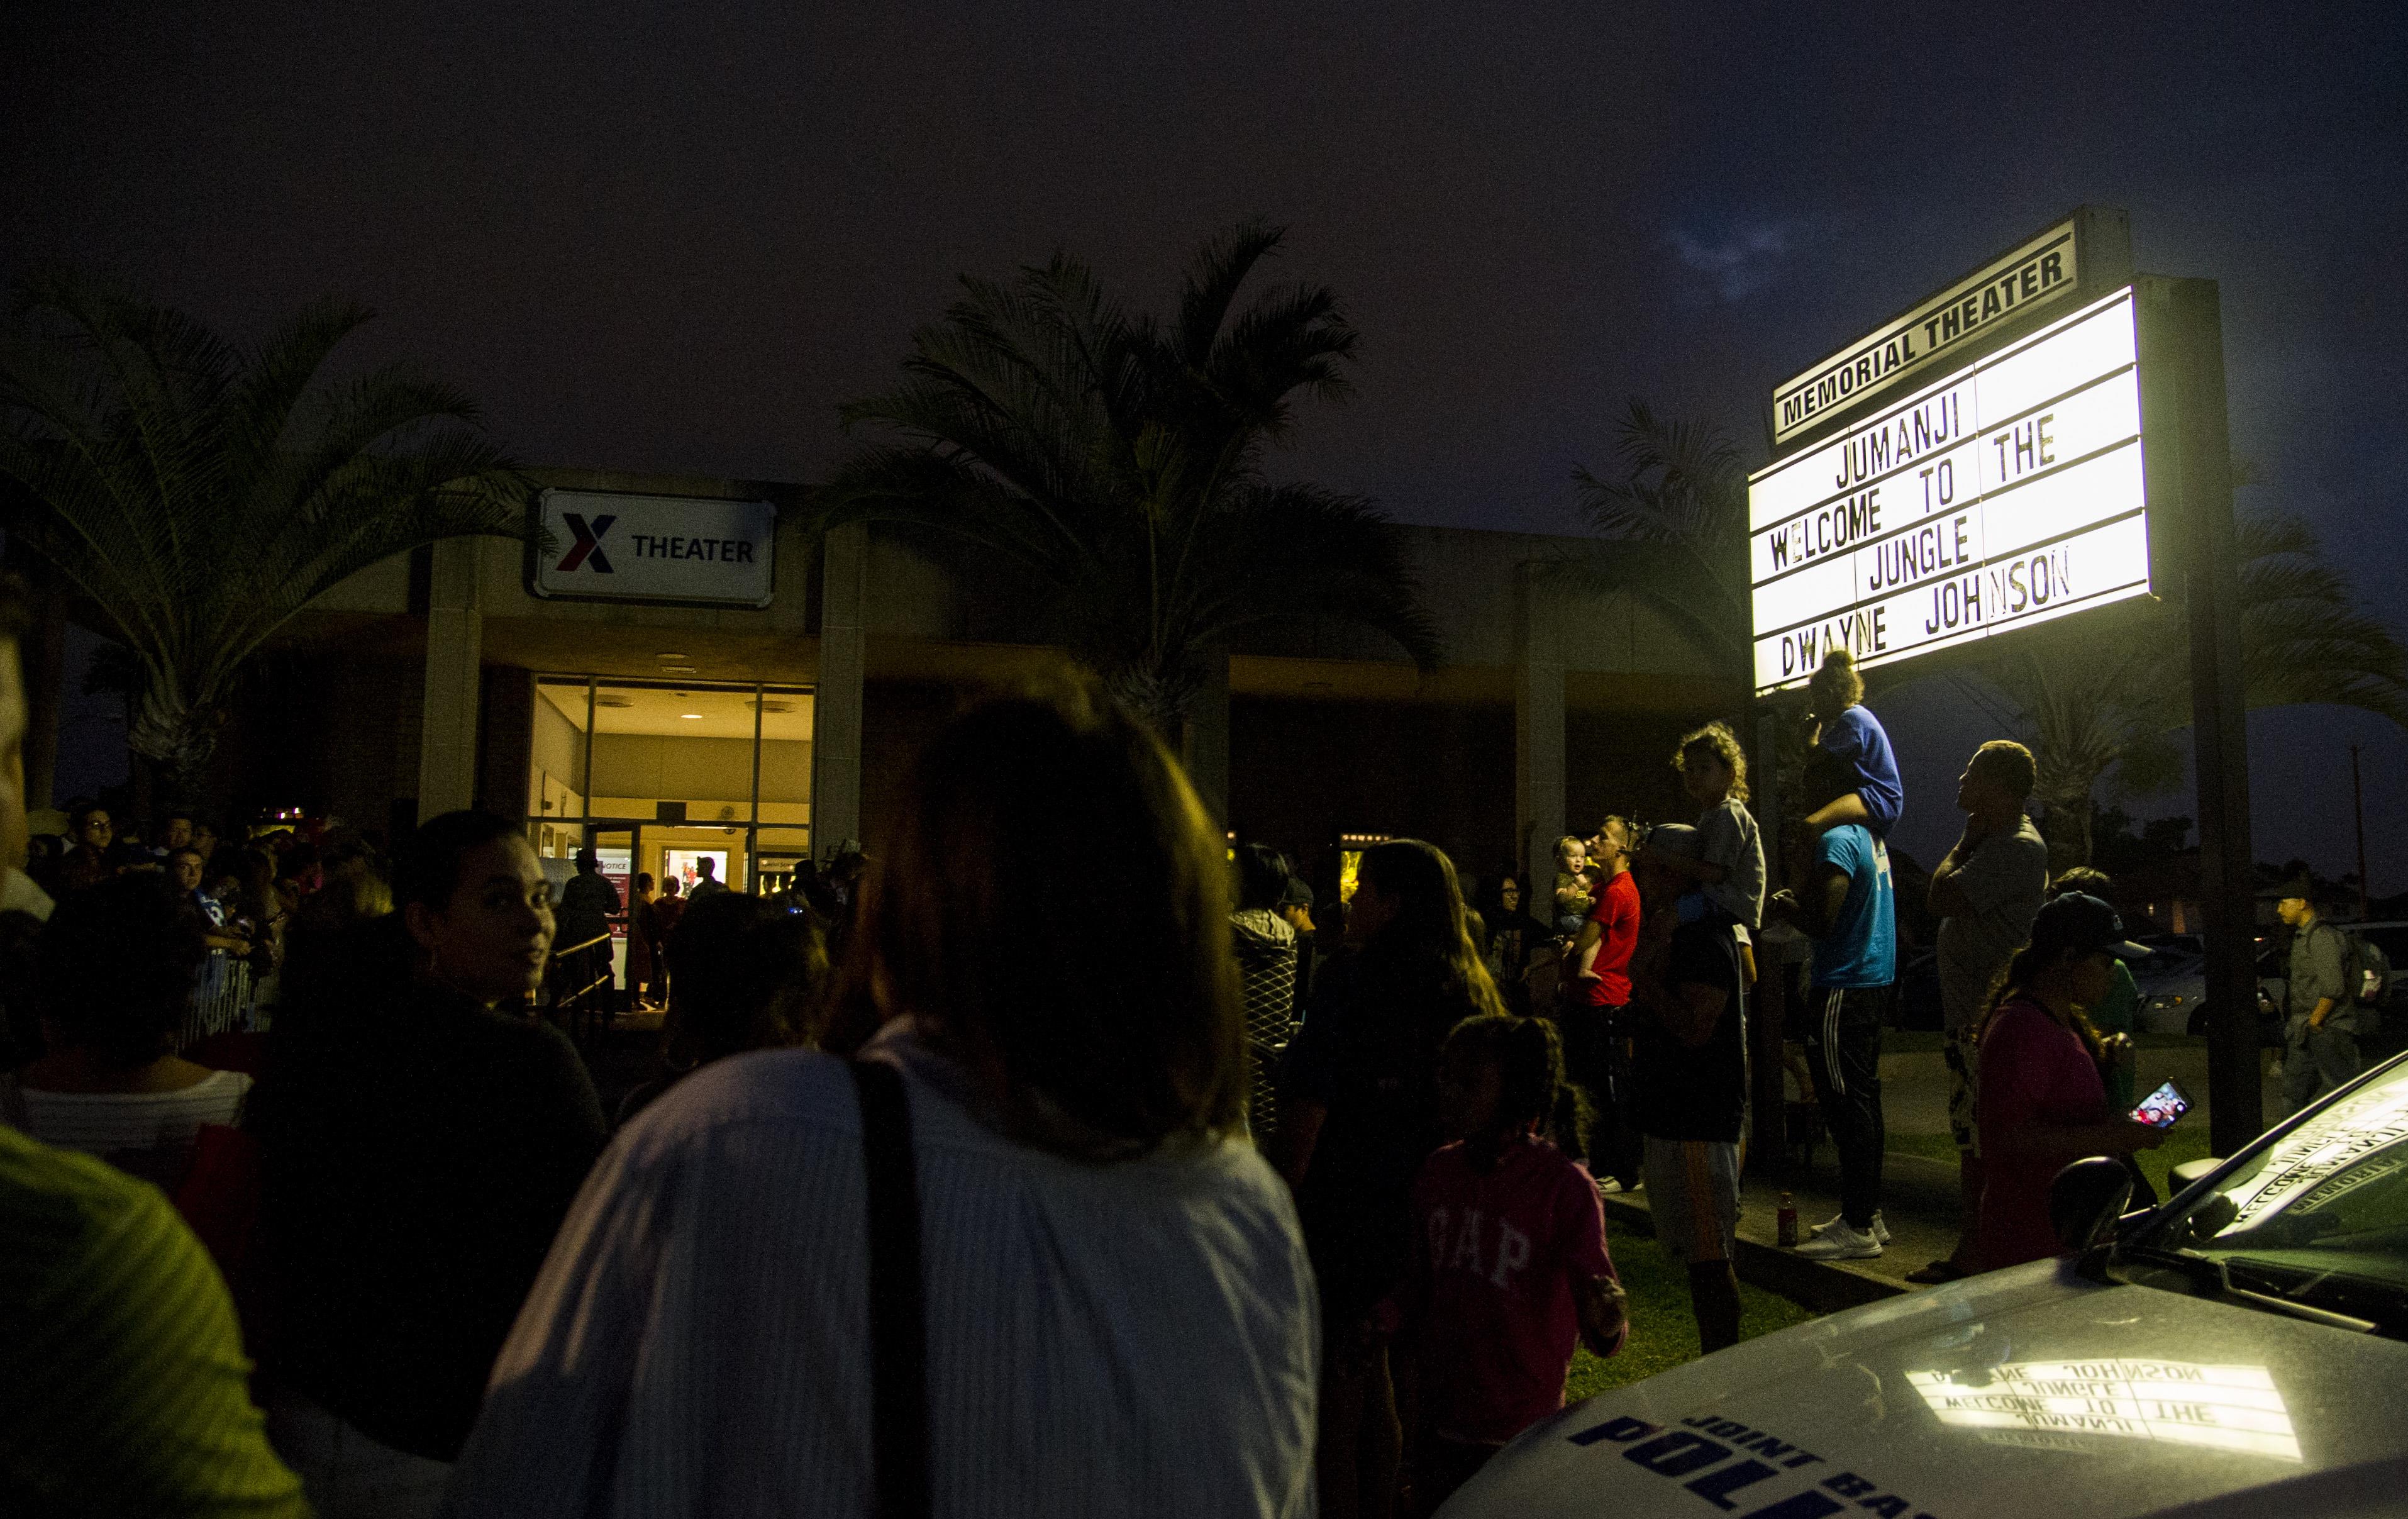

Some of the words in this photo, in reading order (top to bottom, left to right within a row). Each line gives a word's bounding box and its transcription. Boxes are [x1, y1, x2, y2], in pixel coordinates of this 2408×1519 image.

[1784, 334, 1916, 426] MEMORIAL
[1925, 252, 2062, 350] THEATER
[1770, 488, 1881, 571] WELCOME
[1919, 459, 1953, 514] TO
[1994, 413, 2055, 482] THE
[1836, 392, 1959, 489] JUMANJI
[557, 513, 616, 573] X
[631, 535, 753, 562] THEATER
[1870, 516, 1968, 591] JUNGLE
[1782, 606, 1886, 677] DWAYNE
[1926, 545, 2071, 635] JOHNSON
[1681, 1416, 1824, 1467] JOINT
[1821, 1472, 1938, 1519] BA
